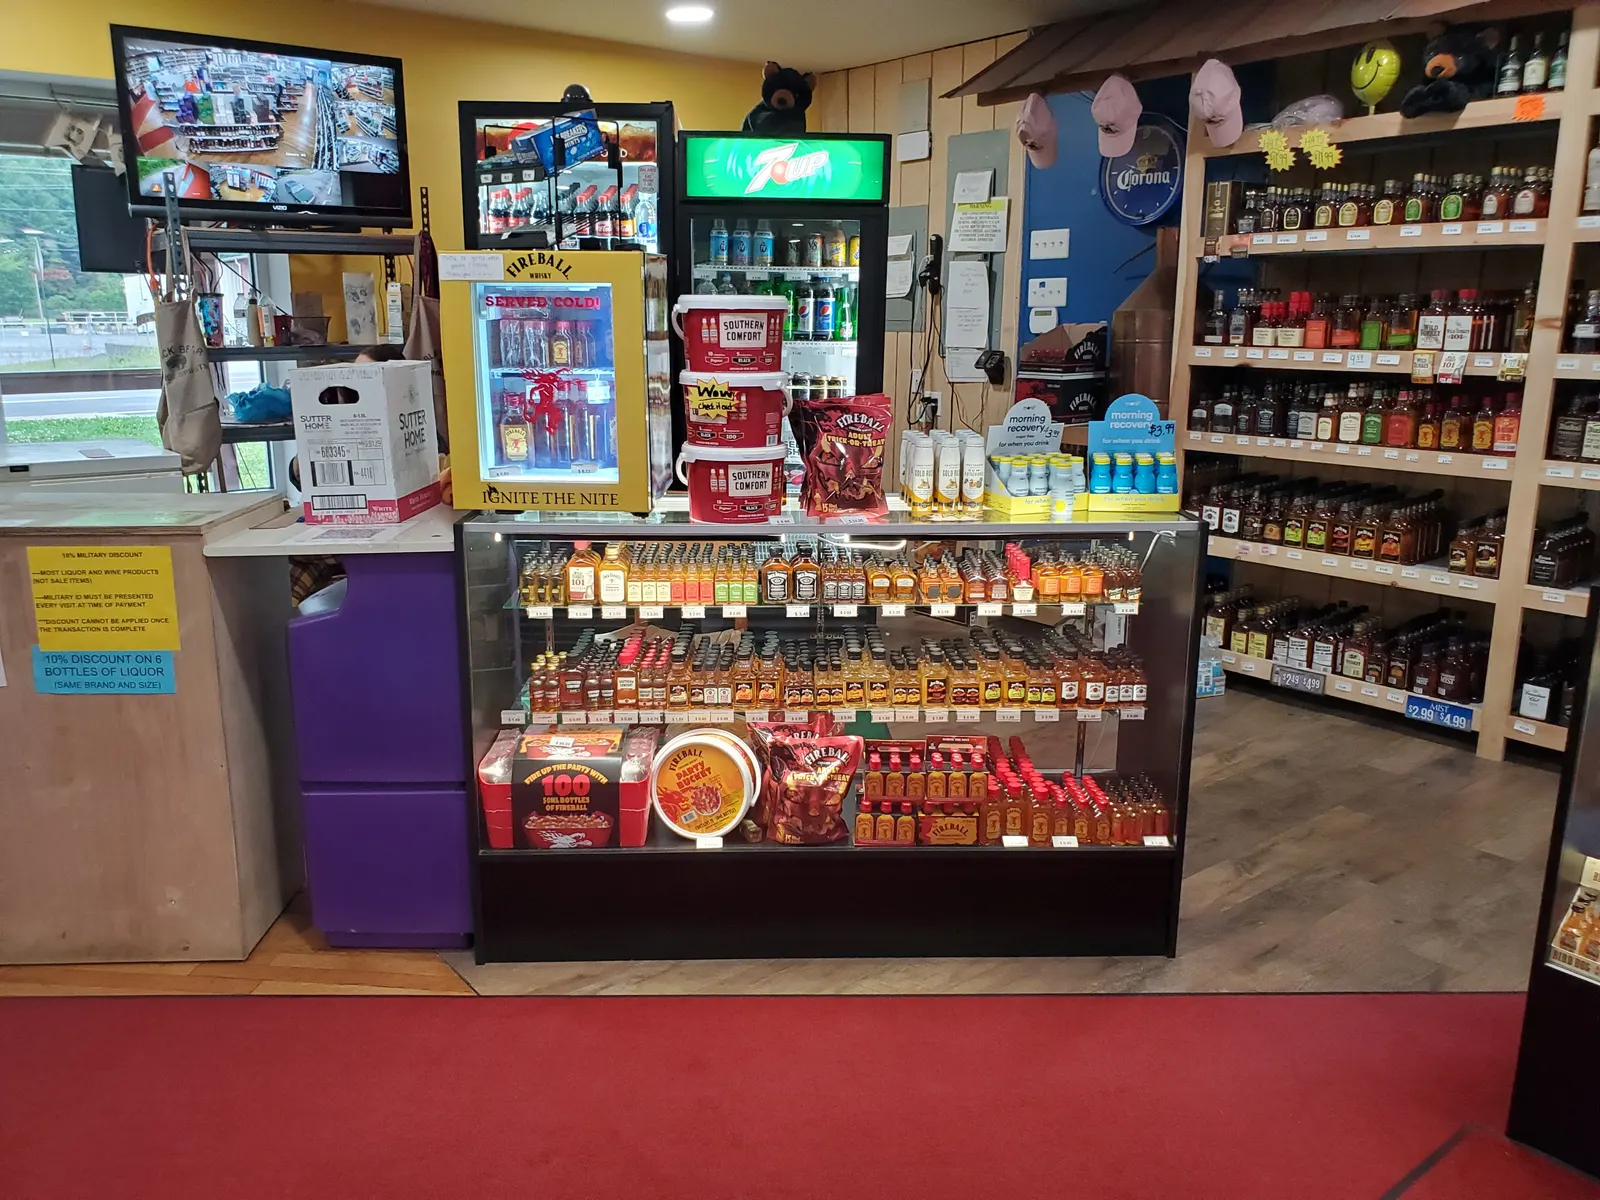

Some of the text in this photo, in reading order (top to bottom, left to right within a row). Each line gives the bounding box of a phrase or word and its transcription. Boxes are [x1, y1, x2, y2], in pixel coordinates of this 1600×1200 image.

[1117, 169, 1170, 191] Corona
[506, 252, 572, 280] FIREBALL
[486, 296, 600, 310] SERVED COLD!
[724, 320, 764, 331] SOUTHERN
[726, 332, 762, 340] COMFORT
[1070, 393, 1097, 411] FIREBALL
[399, 410, 427, 430] SUTTER
[836, 413, 886, 431] FIREBALL
[1010, 414, 1046, 424] morning
[1111, 410, 1153, 421] morning
[1008, 425, 1045, 433] recovery
[1110, 421, 1153, 429] recovery
[1148, 424, 1175, 437] $3.99
[404, 428, 426, 449] HOME
[827, 435, 886, 447] TRICK-OR-TREAT
[848, 432, 872, 440] ADULT
[732, 471, 770, 480] SOUTHERN
[735, 481, 767, 490] COMFORT
[482, 490, 619, 506] IGNITE THE NITE
[45, 654, 162, 664] 10% DISCOUNT ON 6
[45, 667, 164, 677] BOTTLES OF LIQUOR
[54, 681, 162, 690] (SAME BRAND AND SIZE)
[1430, 703, 1449, 713] MIST
[1408, 704, 1466, 728] $2.99 $4.99
[669, 748, 703, 771] FIREBALL
[524, 770, 541, 785] FIRE
[567, 764, 590, 772] PARTY
[589, 770, 608, 784] WITH
[676, 760, 705, 780] PARTY
[676, 766, 712, 789] BUCKET
[542, 774, 590, 796] 100
[932, 823, 969, 836] FIREBALL
